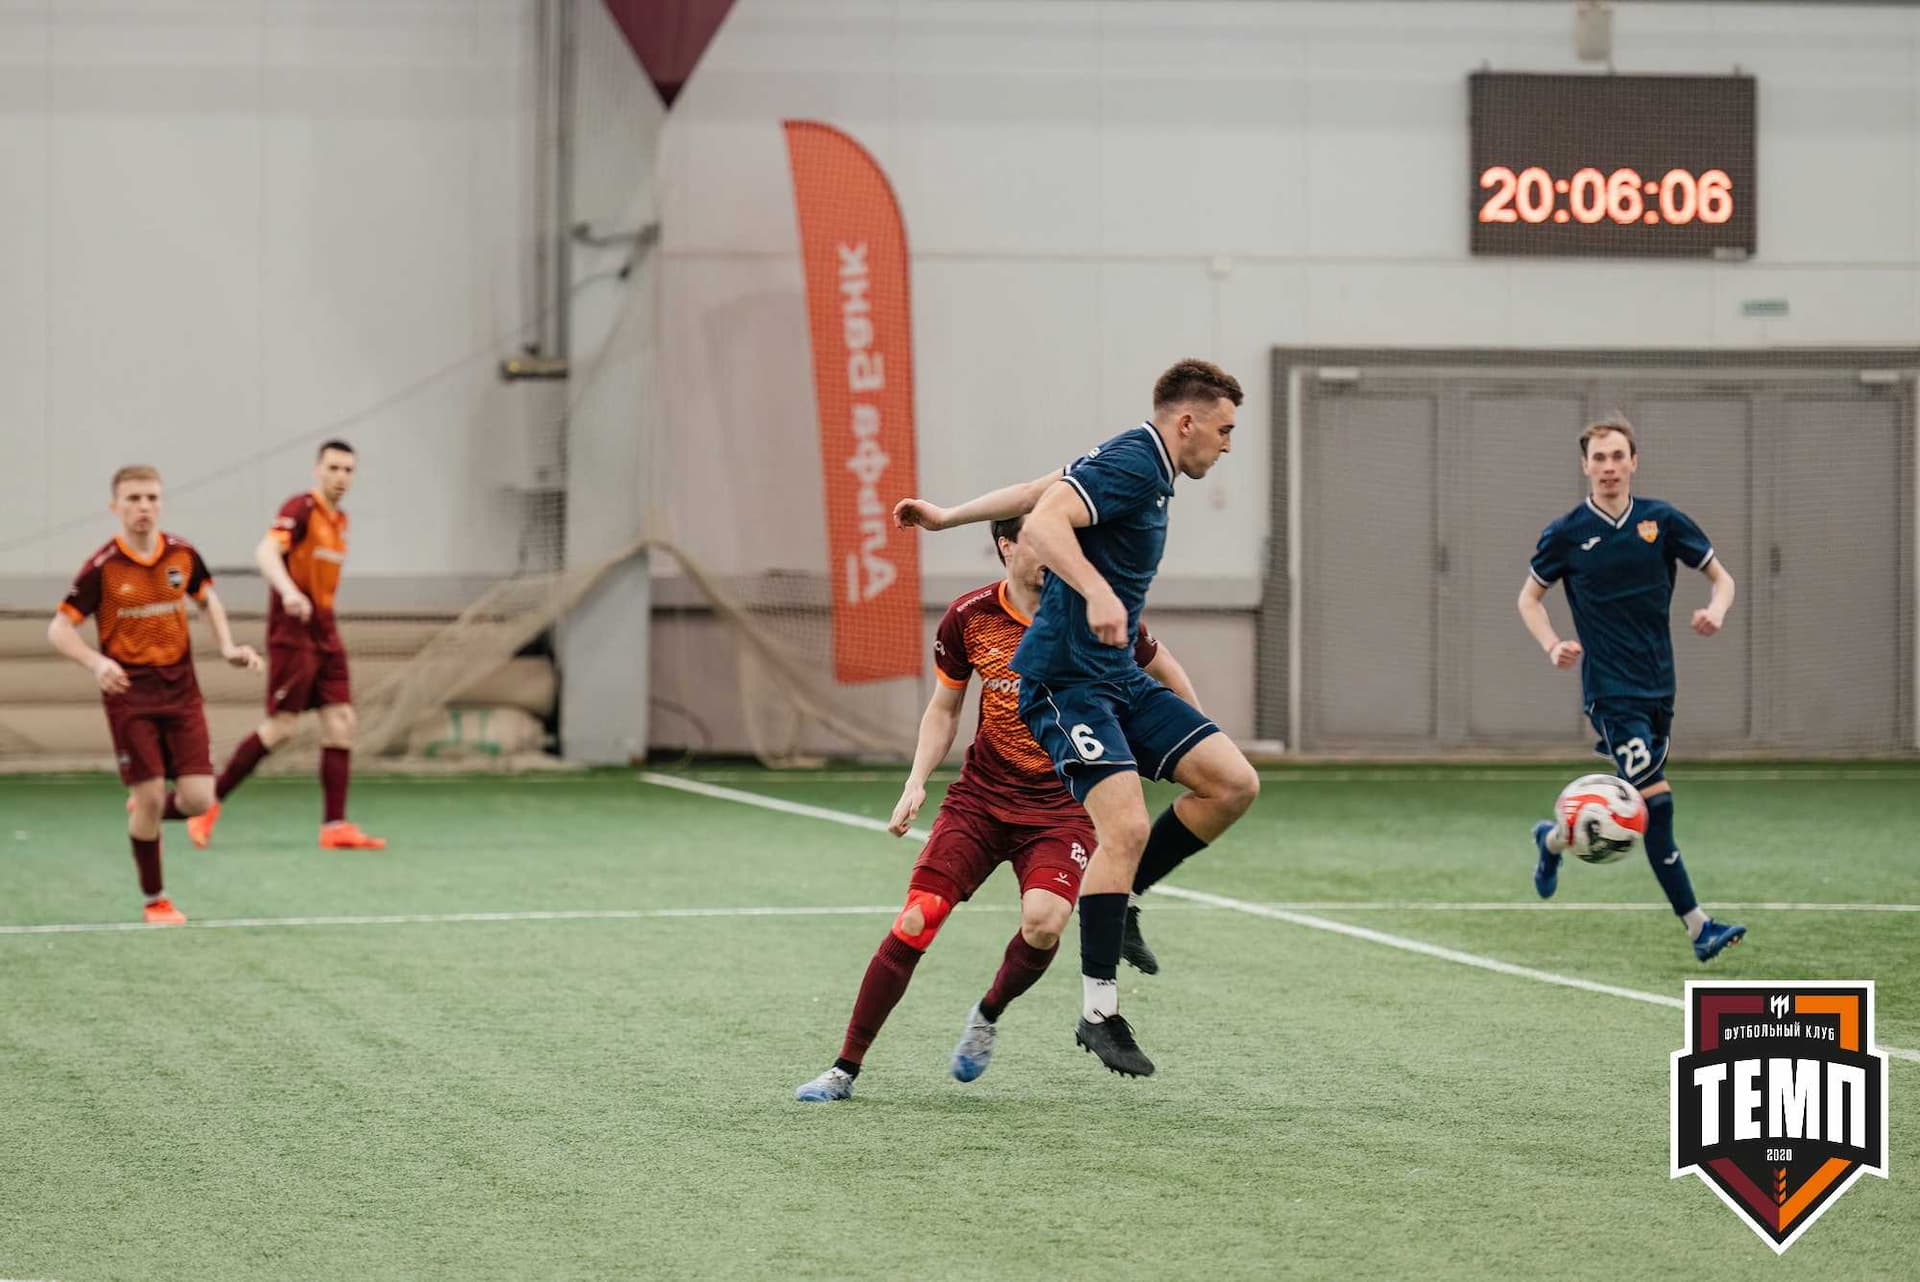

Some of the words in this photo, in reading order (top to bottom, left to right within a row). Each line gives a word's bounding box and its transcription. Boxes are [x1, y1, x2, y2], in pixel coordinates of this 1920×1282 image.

[1479, 166, 1733, 224] 20:06:06
[1070, 723, 1105, 760] 6
[1616, 737, 1651, 778] 23
